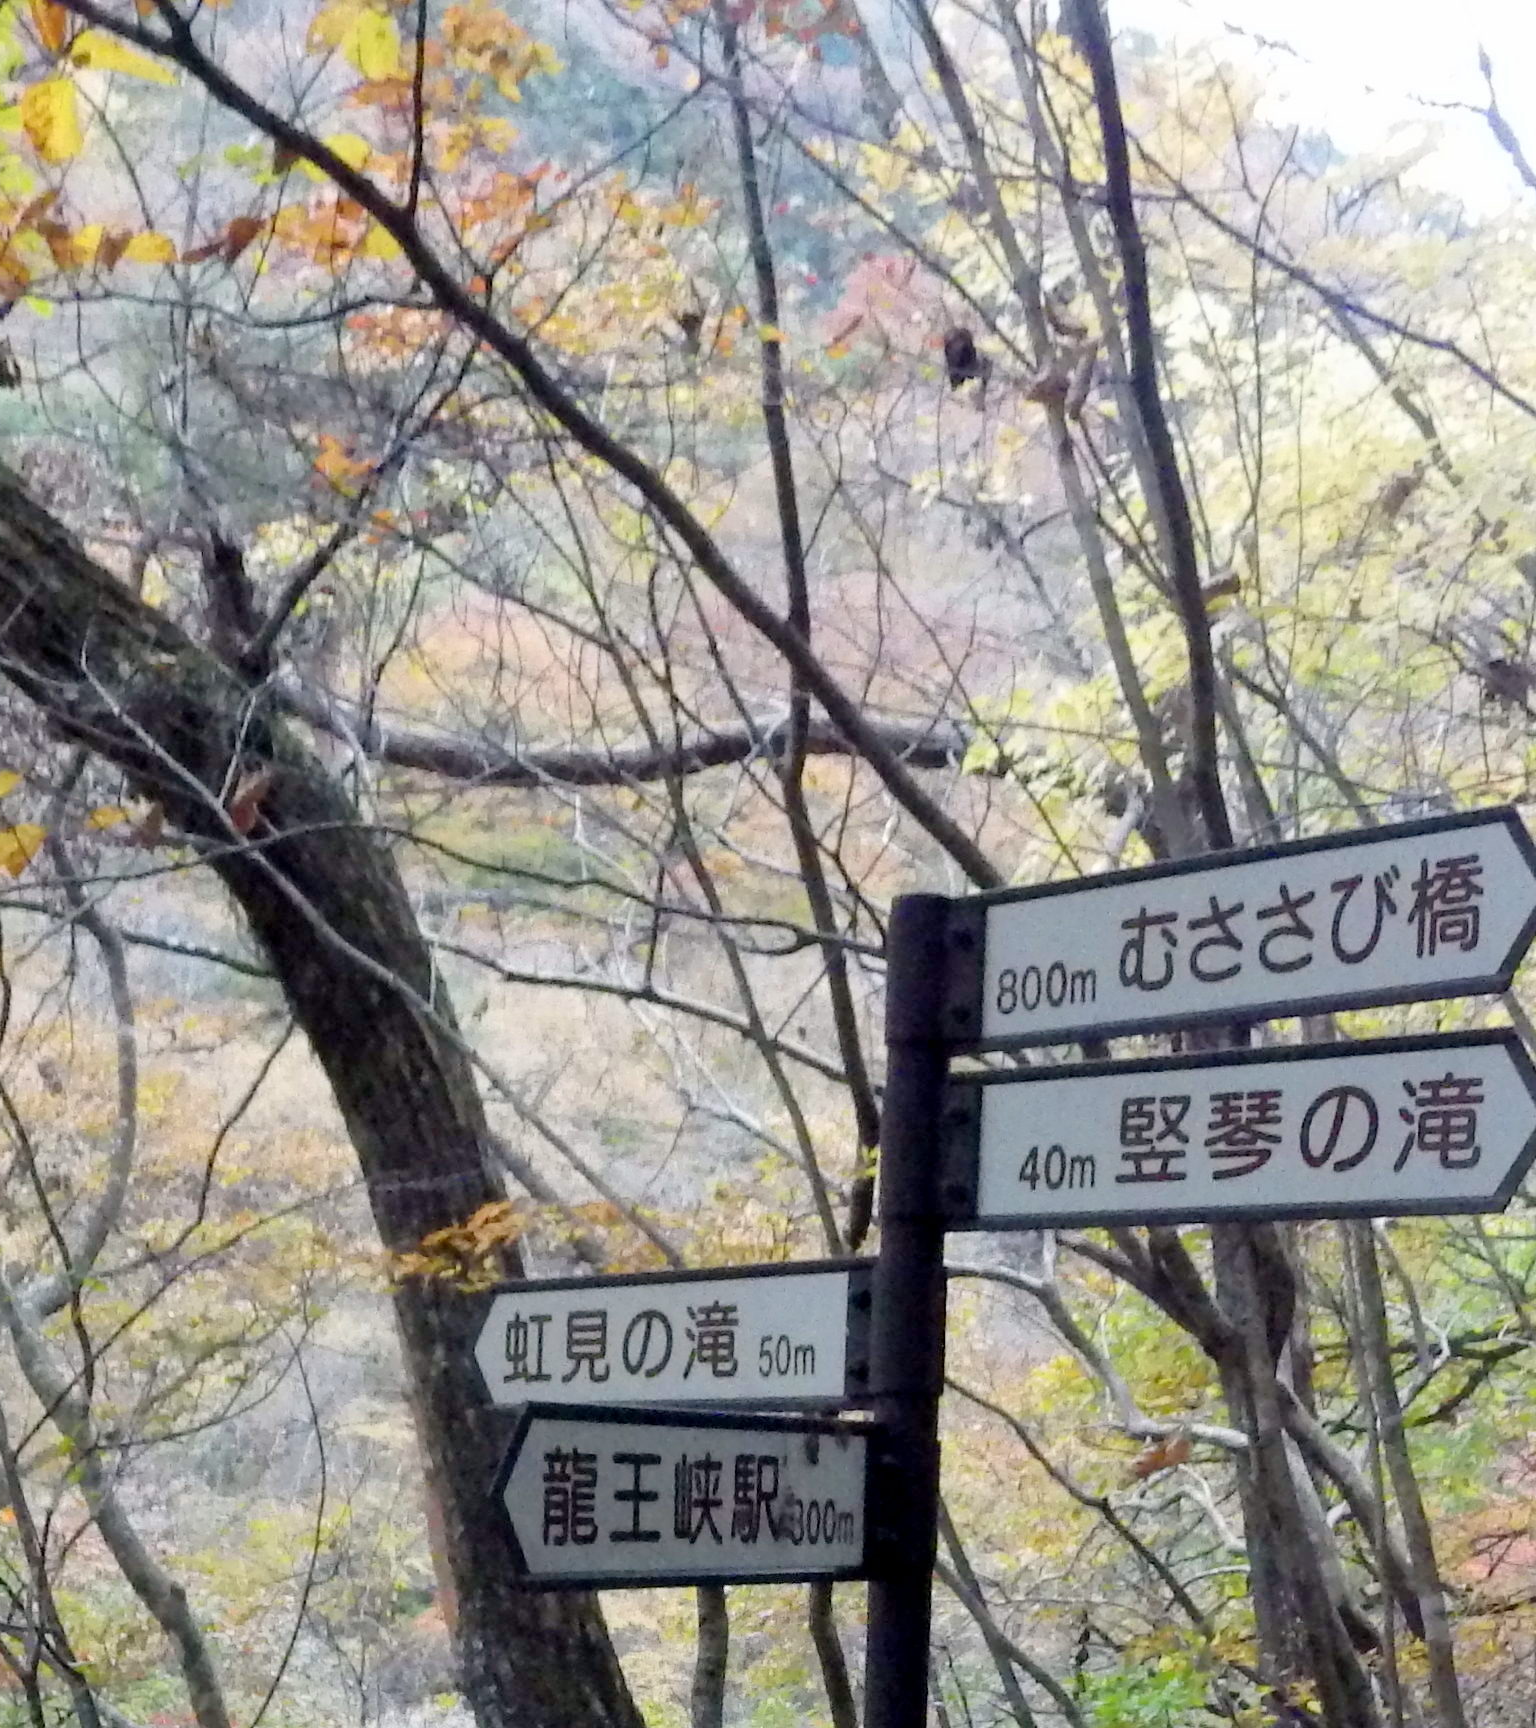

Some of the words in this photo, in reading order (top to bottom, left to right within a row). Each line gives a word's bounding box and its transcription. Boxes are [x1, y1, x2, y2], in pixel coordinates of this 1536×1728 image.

[995, 961, 1098, 1014] 800m
[1117, 853, 1485, 991] むささび橋
[1018, 1144, 1096, 1190] 40m
[1114, 1072, 1485, 1184] 竪琴の滝
[502, 1300, 740, 1384] 虹見の滝
[757, 1334, 816, 1377] 50m
[541, 1445, 781, 1545] 龍王峡駅
